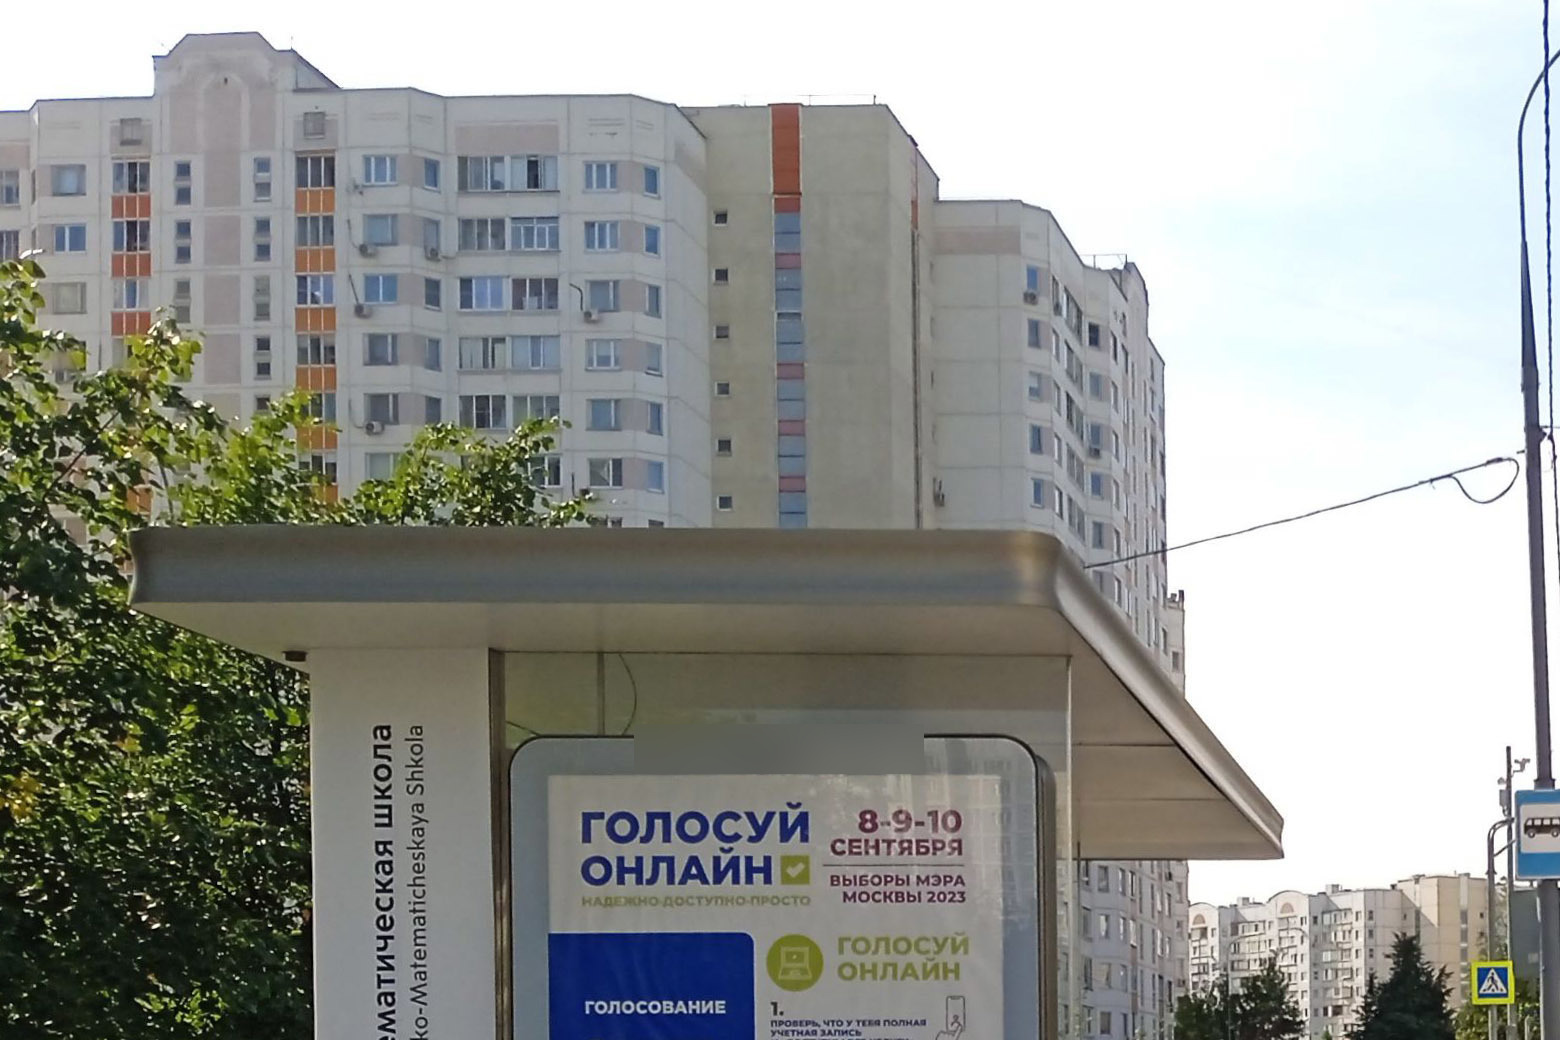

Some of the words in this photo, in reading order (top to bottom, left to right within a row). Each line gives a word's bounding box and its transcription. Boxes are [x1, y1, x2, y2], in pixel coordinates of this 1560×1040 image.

[404, 725, 424, 796] Shkola
[373, 724, 393, 828] школа
[581, 801, 809, 844] ГОЛОСУЙ
[858, 809, 962, 834] 8-9-10
[830, 838, 963, 856] СЕНТЯБРЯ
[580, 846, 773, 886] ОНЛАЙН
[830, 874, 910, 887] ВЫБОРЫ
[916, 874, 965, 887] МЭРА
[842, 891, 922, 904] МОСКВЫ
[927, 891, 966, 904] 2023
[837, 931, 969, 956] ГОЛОСУЙ
[837, 957, 961, 981] ОНЛАЙН
[585, 1000, 726, 1014] ГОЛОСОВАНИЕ
[770, 1001, 784, 1016] 1.
[770, 1029, 818, 1037] УЧЕТНАЯ
[820, 1029, 862, 1037] ЗАПИСЬ
[824, 1019, 844, 1027] ЧТО
[846, 1019, 853, 1027] У
[856, 1019, 881, 1027] ТЕБЯ
[883, 1019, 927, 1027] ПОЛНАЯ
